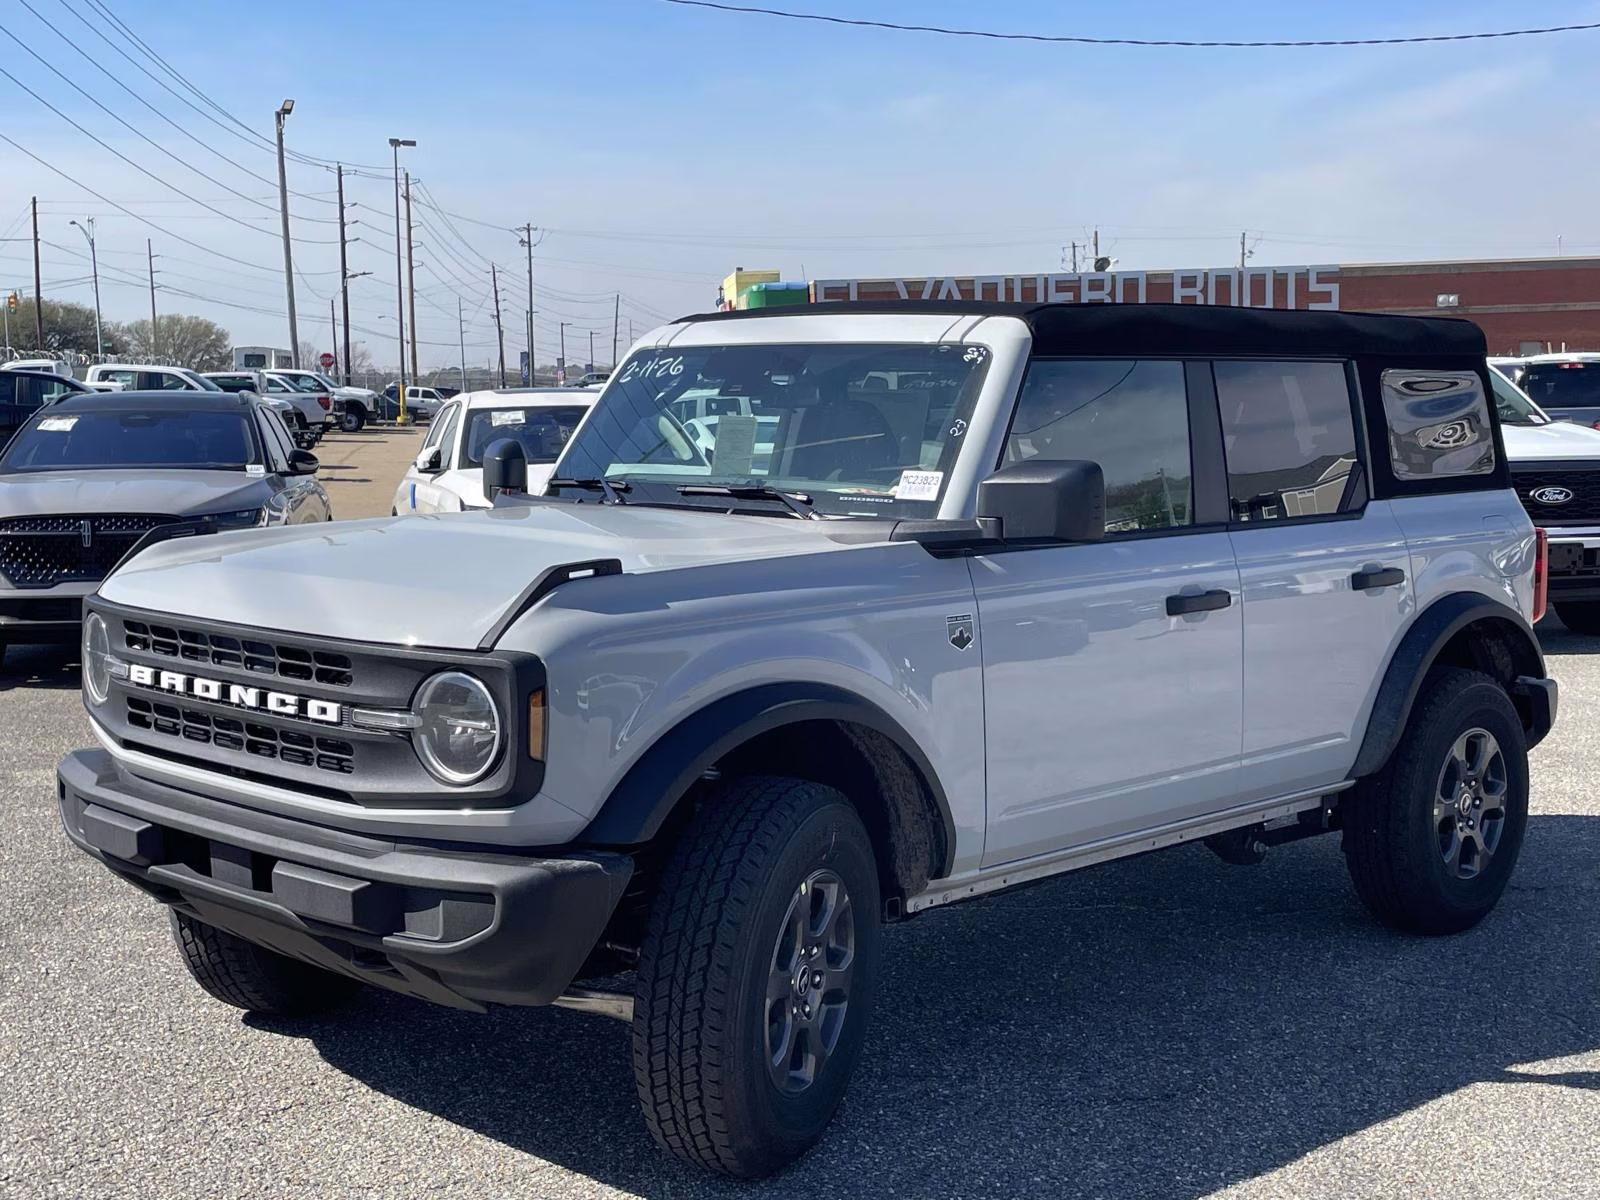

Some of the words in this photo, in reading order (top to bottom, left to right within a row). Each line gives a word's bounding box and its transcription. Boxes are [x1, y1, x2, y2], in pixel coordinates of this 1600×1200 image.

[1174, 264, 1340, 311] BOOTS
[1542, 490, 1566, 501] Ford
[130, 664, 342, 723] BRONCO
